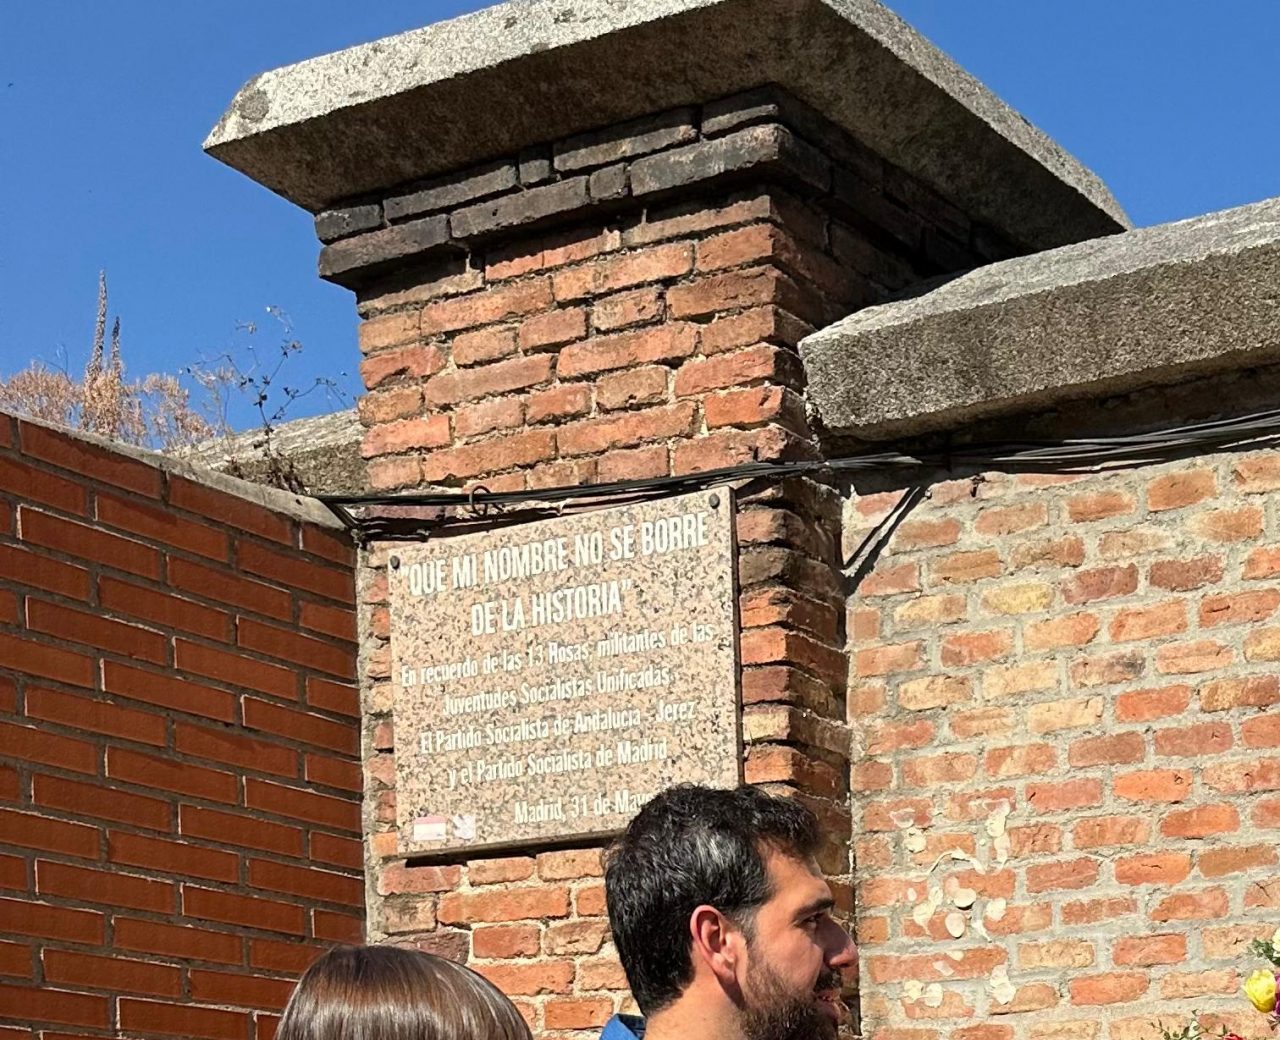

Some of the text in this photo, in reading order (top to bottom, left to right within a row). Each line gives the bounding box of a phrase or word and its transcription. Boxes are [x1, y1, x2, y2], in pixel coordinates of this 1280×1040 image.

[452, 554, 478, 588] MI
[484, 537, 568, 584] NOMBRE
[575, 531, 603, 567] NO
[610, 524, 635, 560] SE
[641, 511, 709, 556] BORRE
[471, 601, 496, 636] DE
[501, 597, 525, 631] LA
[401, 665, 416, 687] En
[420, 656, 478, 685] recuerdo
[483, 652, 499, 675] de
[503, 649, 522, 672] las
[528, 644, 544, 668] 13
[597, 629, 666, 657] militantes
[671, 624, 688, 645] de
[692, 621, 714, 643] las
[443, 678, 592, 715] Juventudes Socialistas
[571, 794, 588, 817] 31
[594, 794, 611, 815] de
